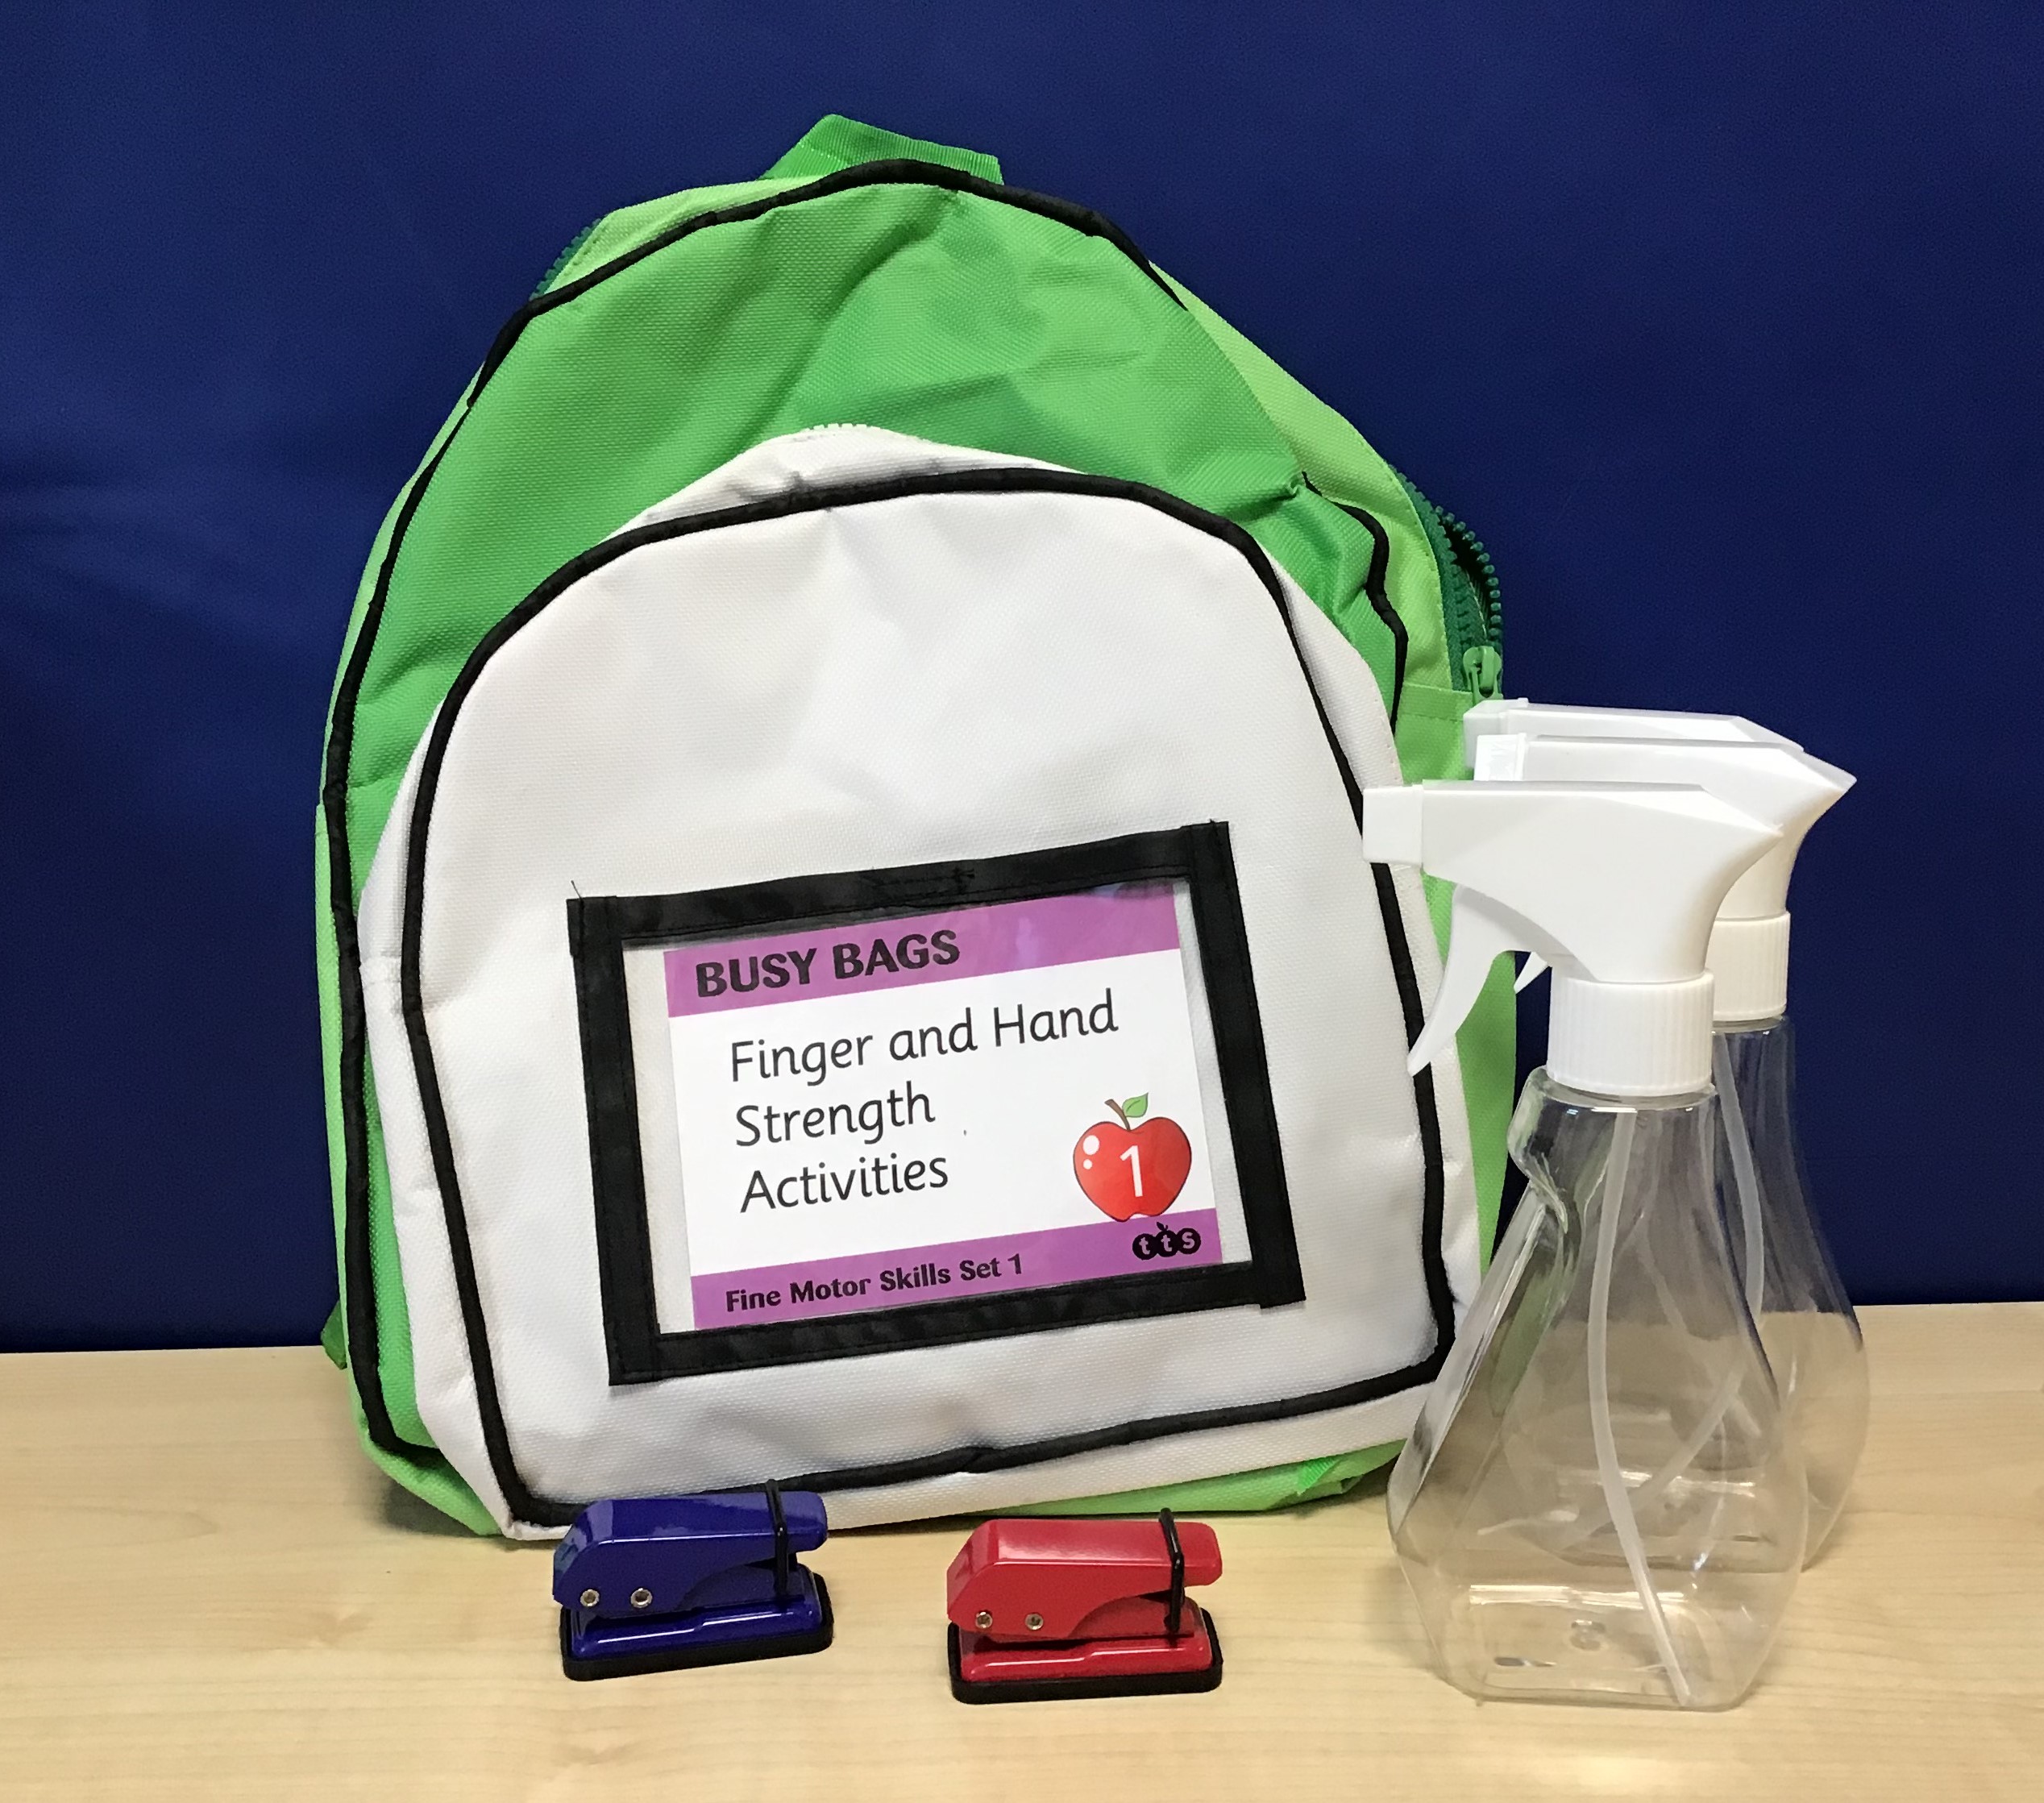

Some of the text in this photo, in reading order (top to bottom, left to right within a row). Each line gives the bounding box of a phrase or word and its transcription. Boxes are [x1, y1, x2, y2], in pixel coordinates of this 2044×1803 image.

[696, 929, 961, 998] BUSY BAGS
[732, 987, 1120, 1086] Finger and Hand
[735, 1080, 936, 1147] Strength
[740, 1153, 949, 1213] Activities
[1120, 1145, 1143, 1198] 1
[1136, 1229, 1197, 1257] tts
[725, 1253, 1022, 1312] Fine Motor Skills Set 1
